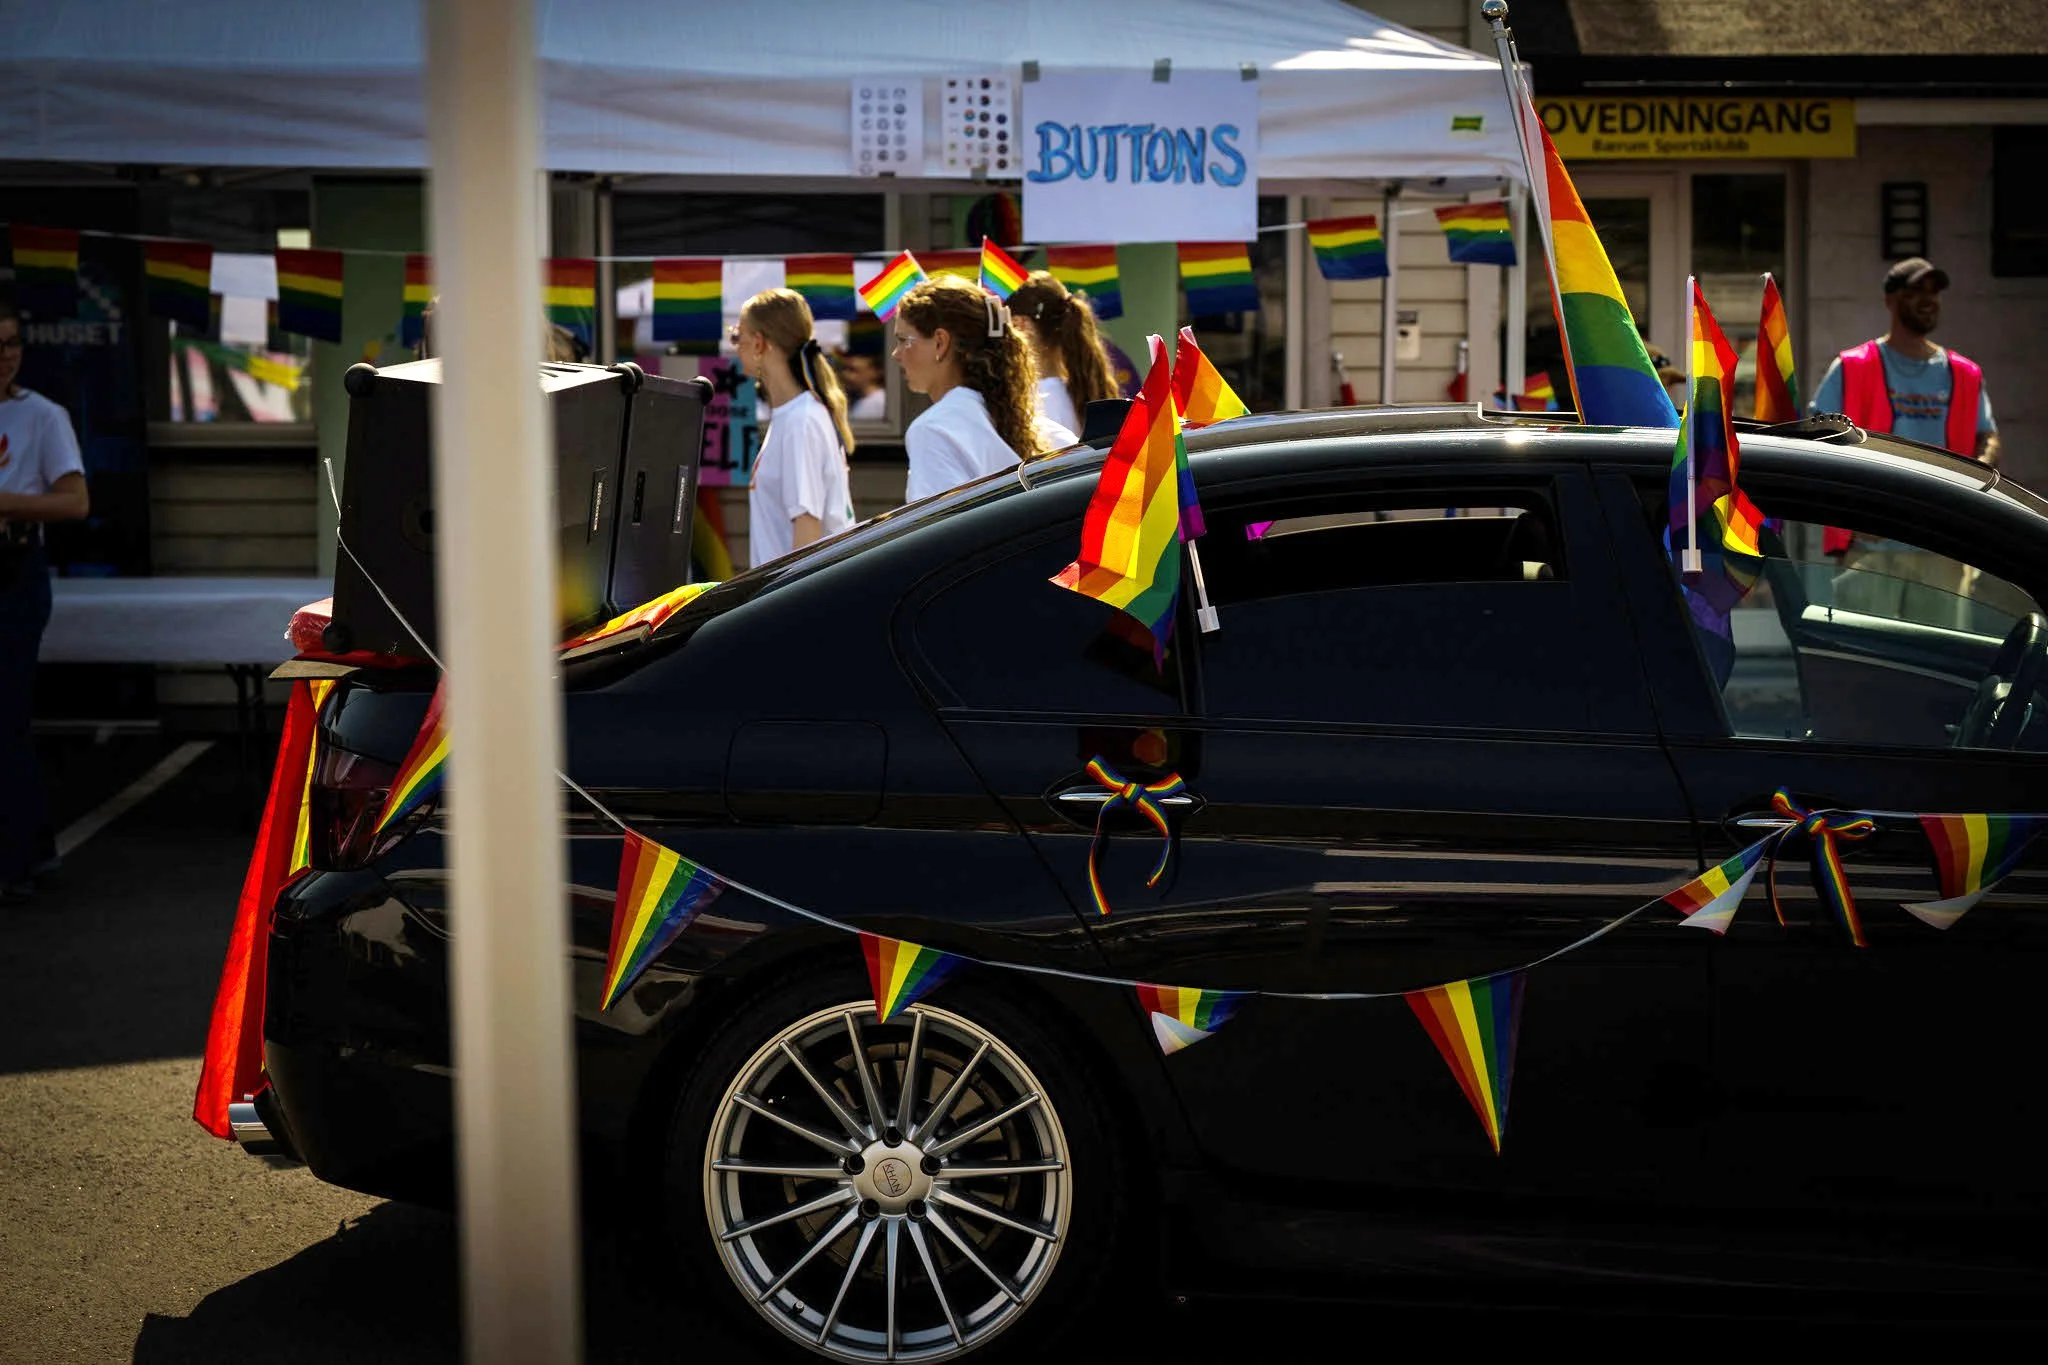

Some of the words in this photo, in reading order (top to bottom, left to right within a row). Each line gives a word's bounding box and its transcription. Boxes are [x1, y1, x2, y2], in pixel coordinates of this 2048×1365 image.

[1543, 101, 1831, 134] OVEDINNGANG
[1027, 120, 1247, 187] BUTTONS
[884, 1163, 902, 1193] KHAN
